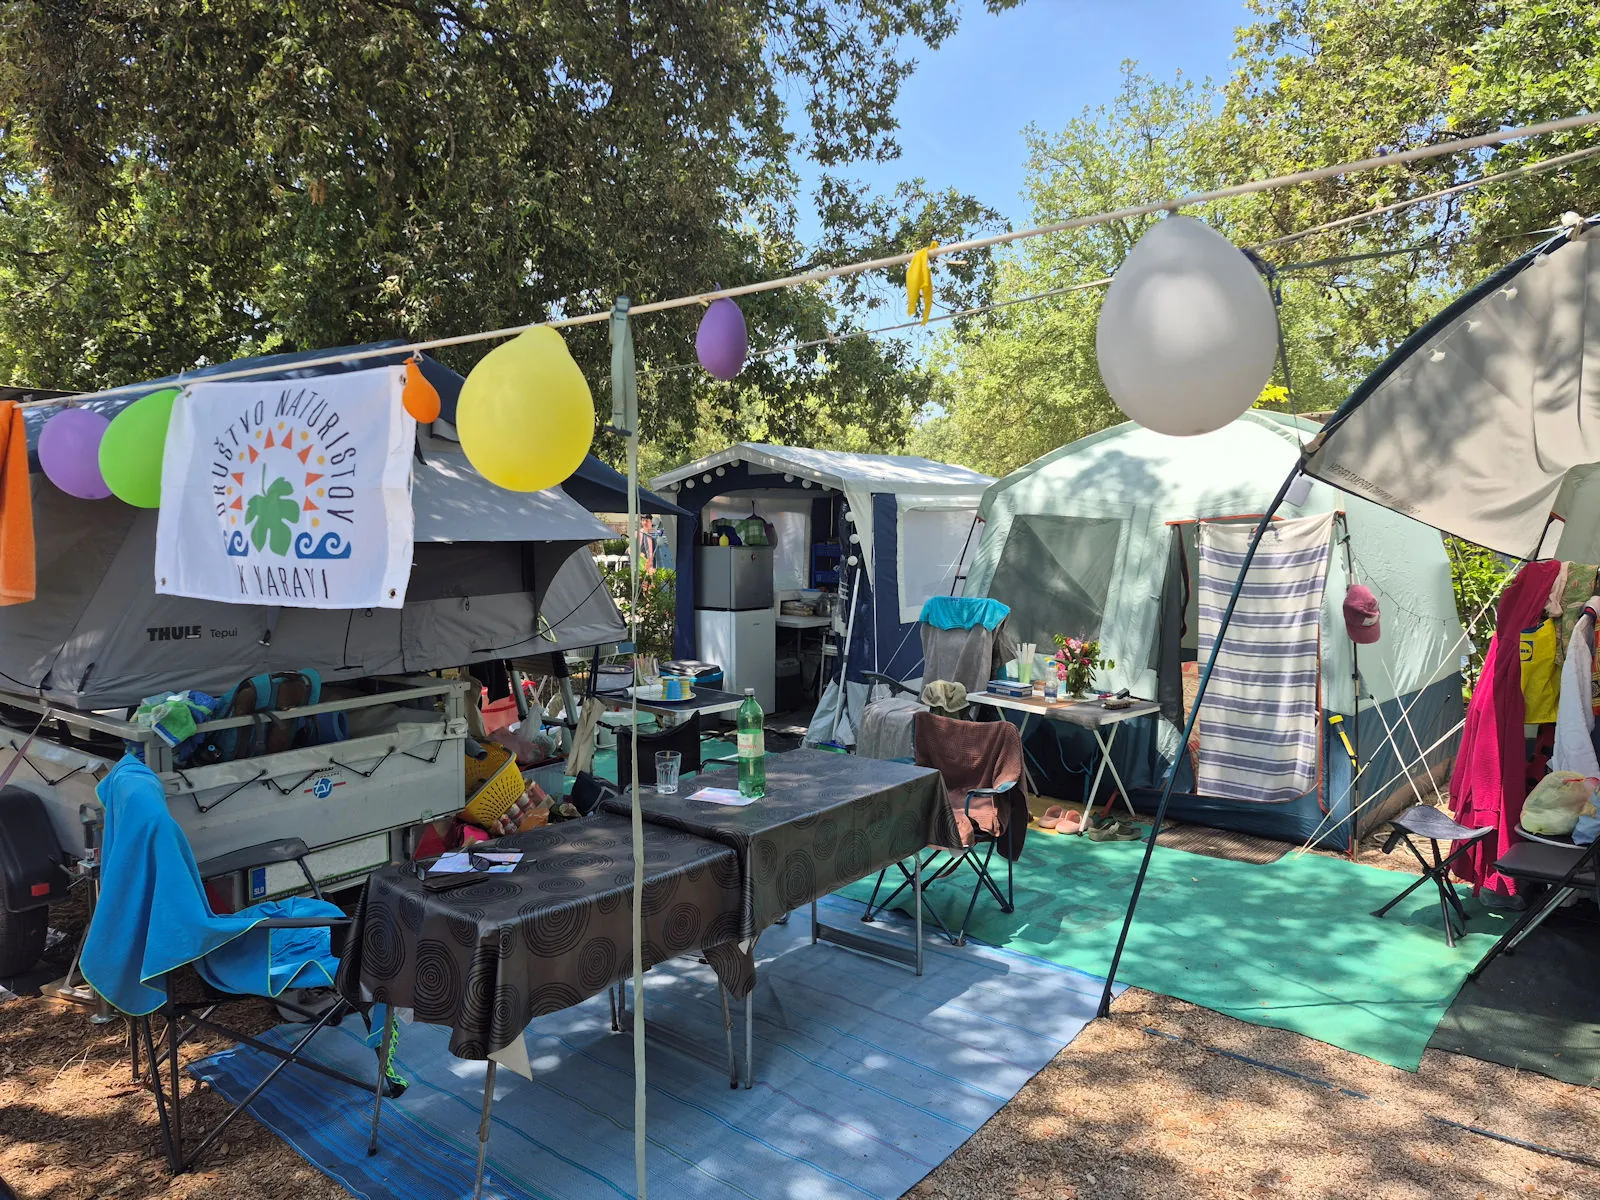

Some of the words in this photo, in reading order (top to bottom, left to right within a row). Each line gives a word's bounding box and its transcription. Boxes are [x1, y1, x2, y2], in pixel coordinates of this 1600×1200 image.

[274, 388, 356, 524] NATURISTOV
[146, 625, 202, 642] THULE
[209, 627, 238, 639] Tepui
[253, 887, 265, 896] SLO
